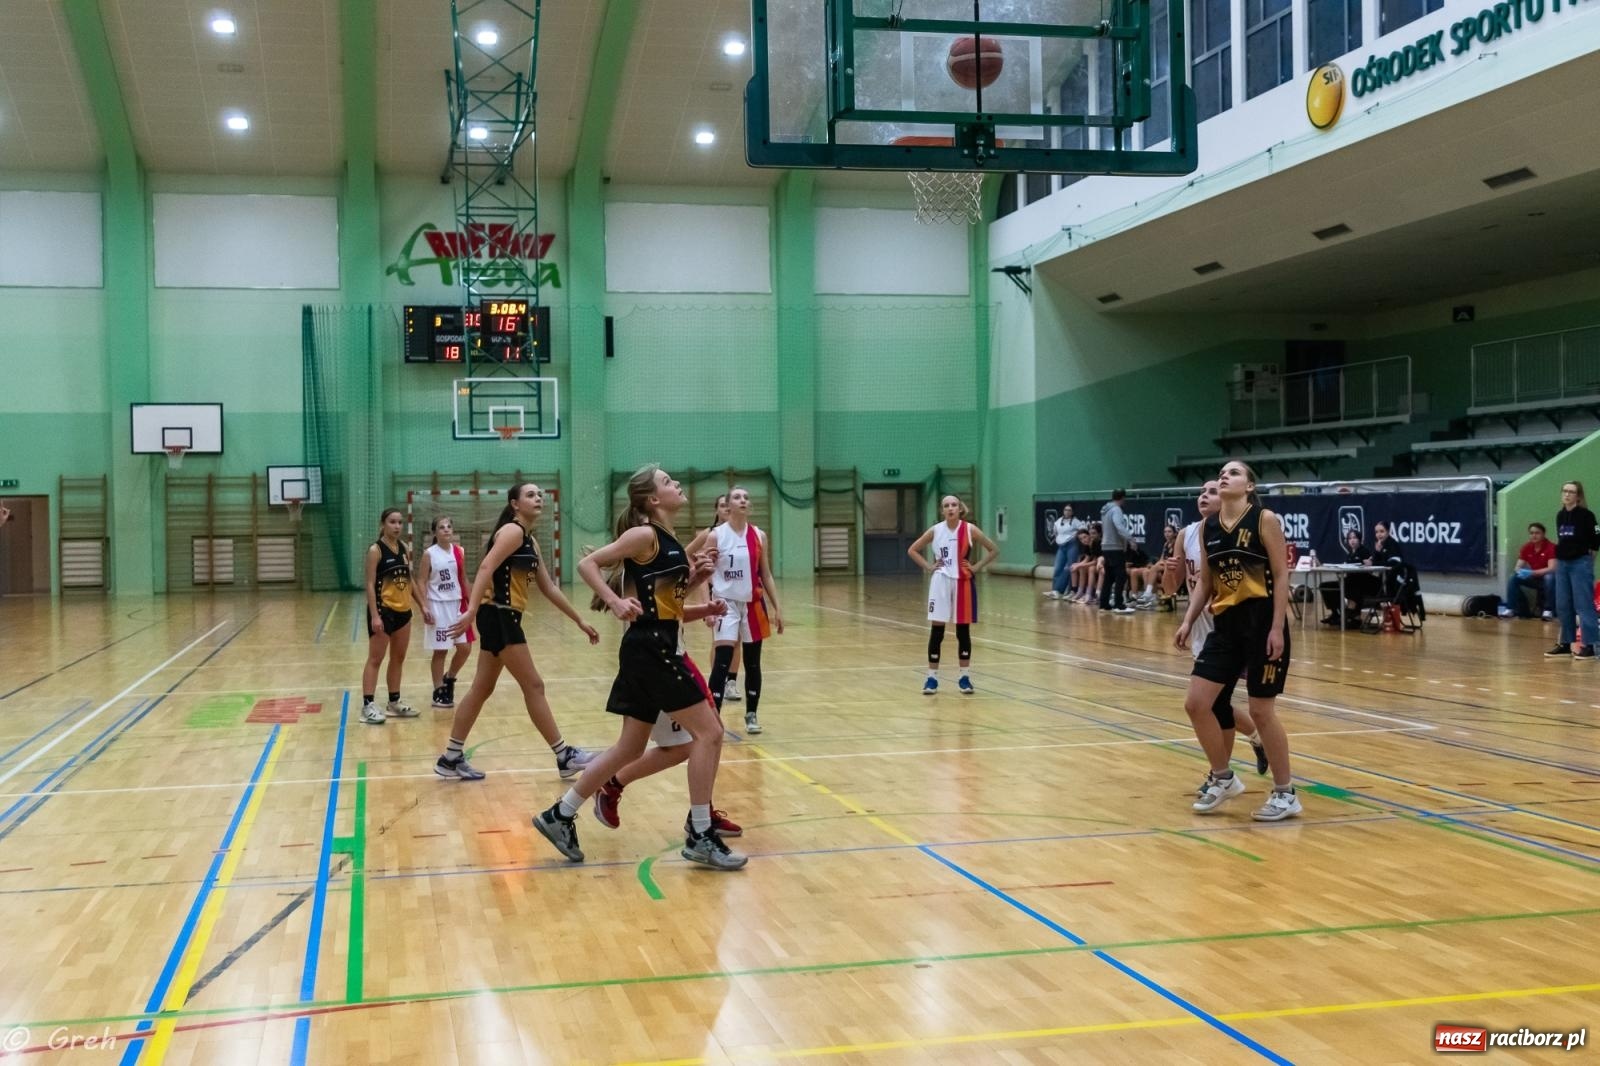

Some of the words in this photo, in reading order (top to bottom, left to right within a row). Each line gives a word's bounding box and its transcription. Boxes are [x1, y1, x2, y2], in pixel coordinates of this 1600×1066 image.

[1351, 30, 1446, 98] OŚRODEK
[1450, 0, 1545, 56] SPORTU
[499, 316, 516, 332] 16
[445, 346, 460, 359] 18
[1236, 528, 1252, 548] 14
[939, 546, 949, 559] 16
[1261, 664, 1277, 685] 14
